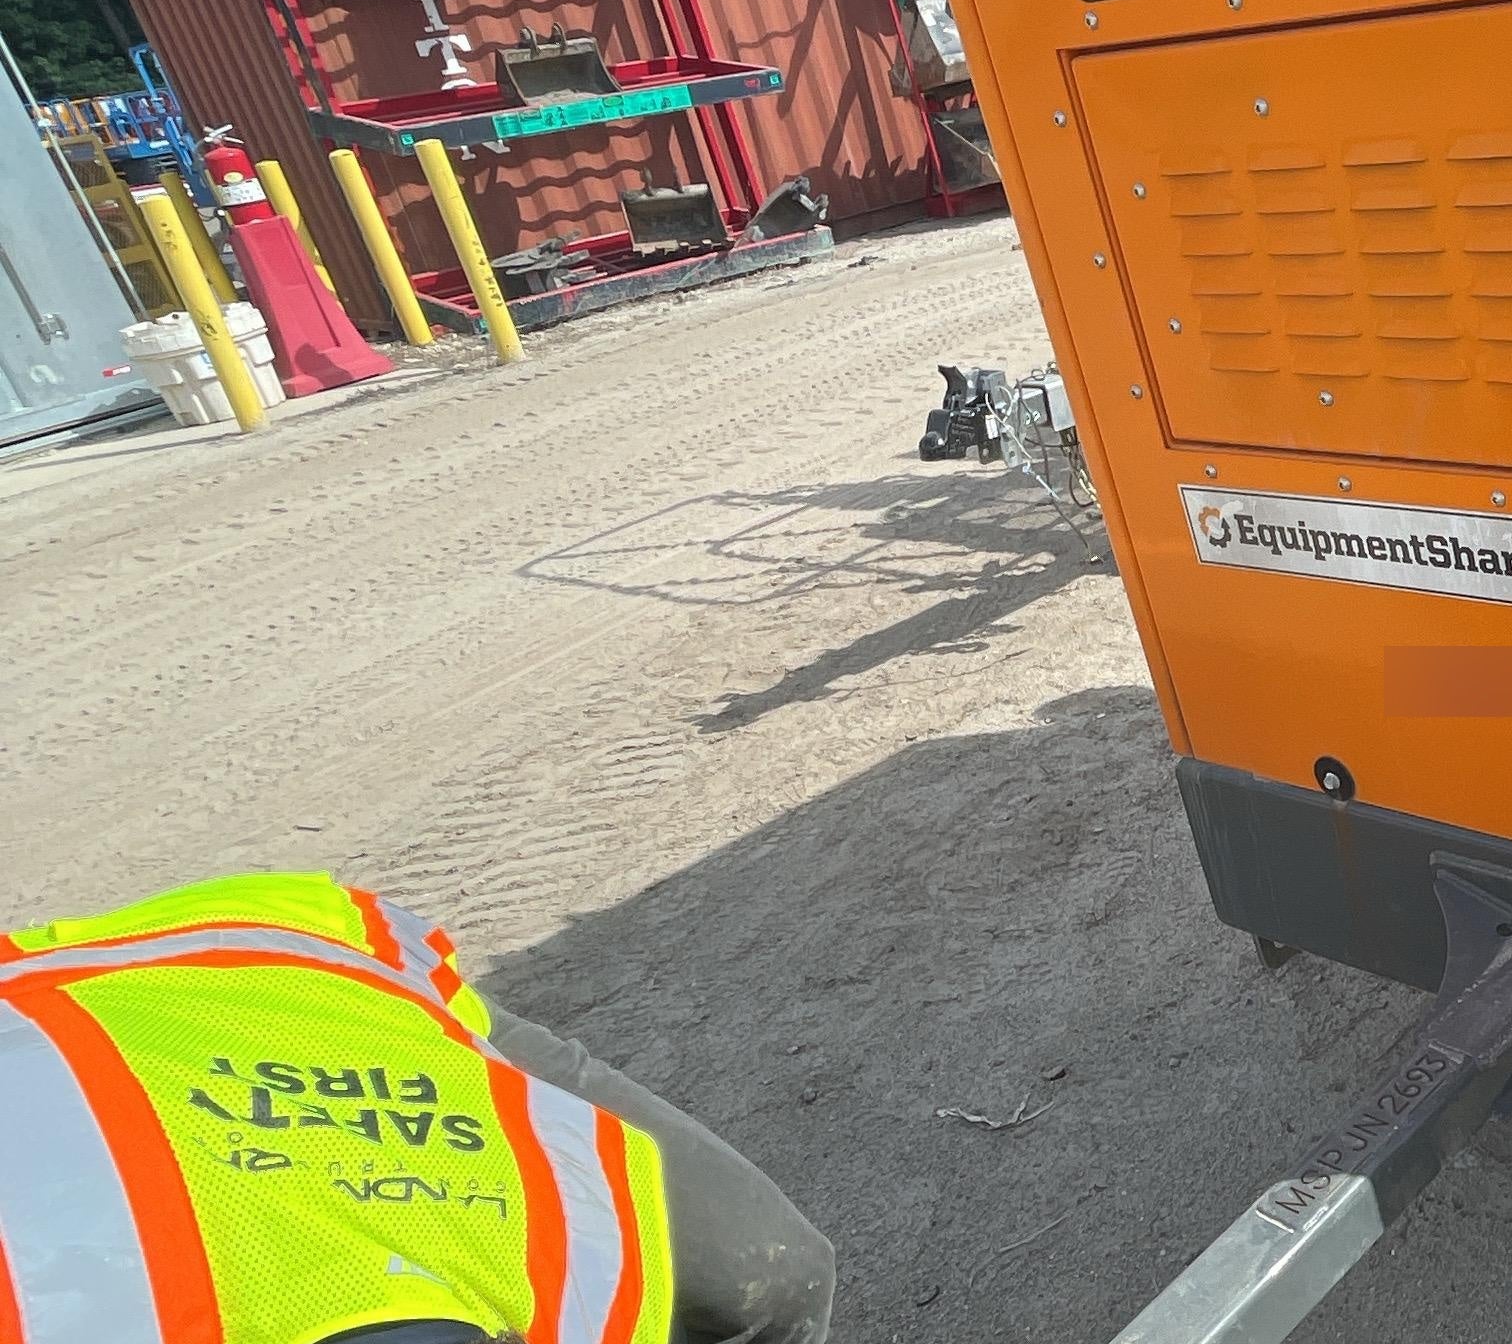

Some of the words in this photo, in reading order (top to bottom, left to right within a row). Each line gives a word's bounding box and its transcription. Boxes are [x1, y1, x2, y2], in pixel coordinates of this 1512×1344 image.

[208, 1056, 438, 1105] FIRST
[1377, 1054, 1448, 1115] 2693
[186, 1086, 485, 1152] SAFETY
